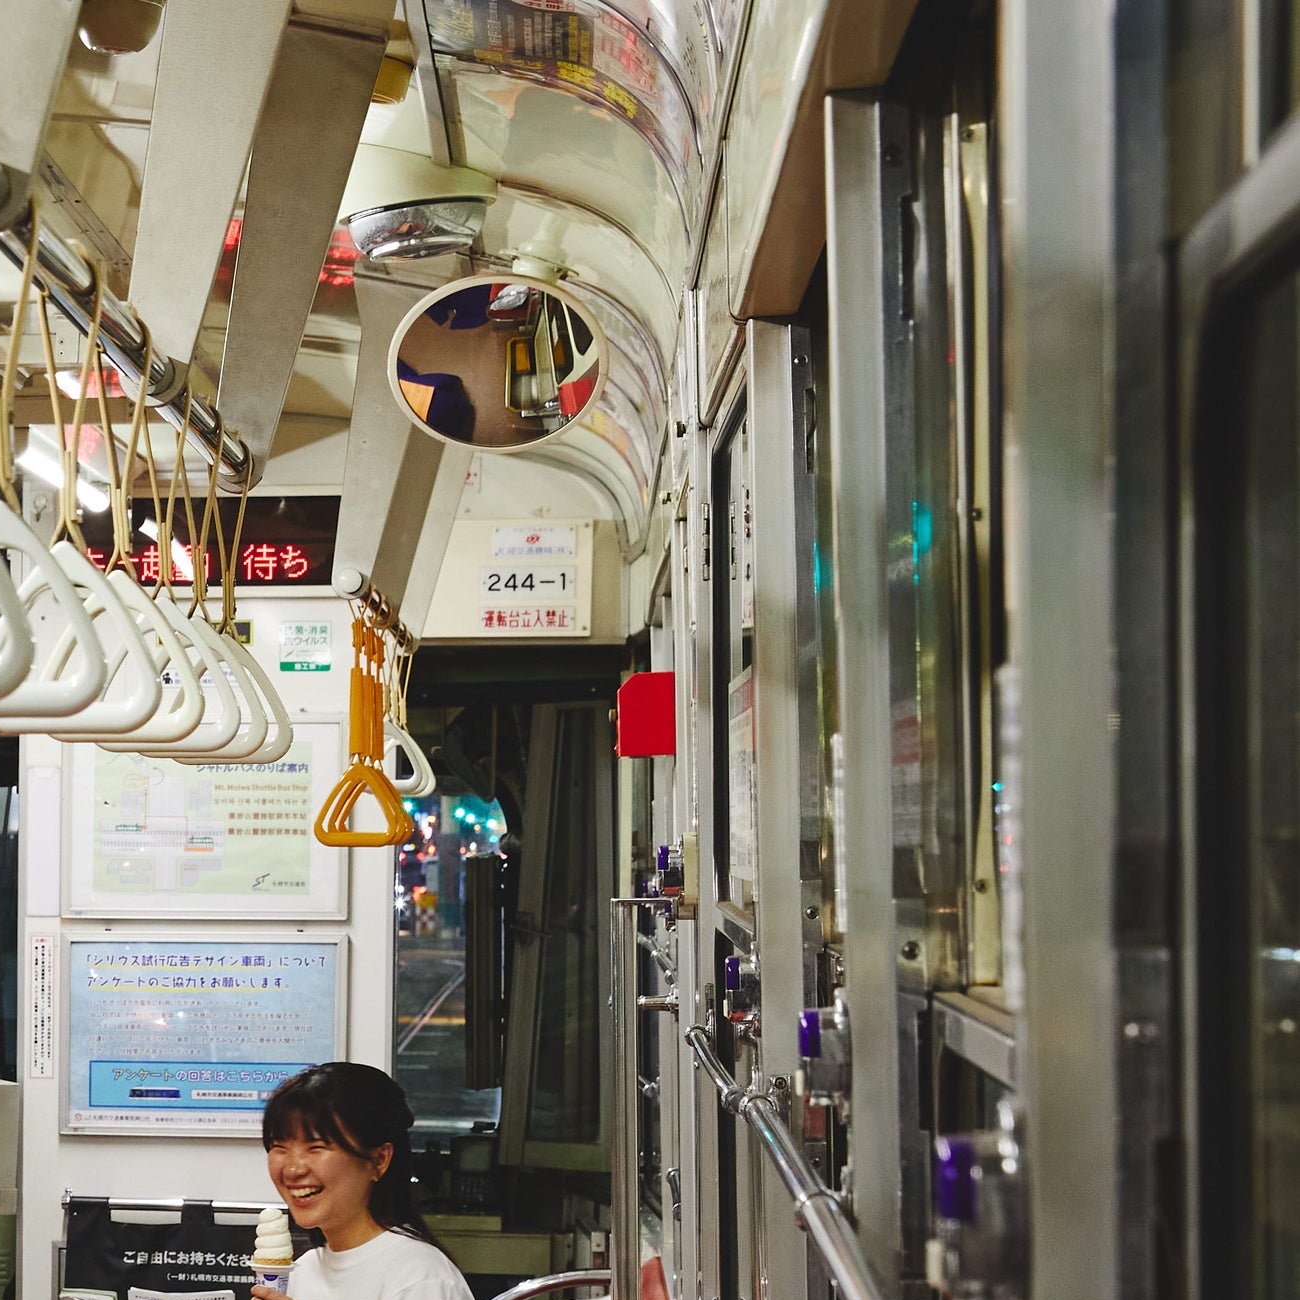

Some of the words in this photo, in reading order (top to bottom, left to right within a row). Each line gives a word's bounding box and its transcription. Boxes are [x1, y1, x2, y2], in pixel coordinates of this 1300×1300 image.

[243, 543, 309, 581] 待ち
[488, 573, 567, 591] 244-1
[484, 609, 569, 629] 運転台立入禁止
[87, 975, 291, 989] アンケートのご協力をお願いします。
[123, 1250, 253, 1267] ご自由にお持ちくださ
